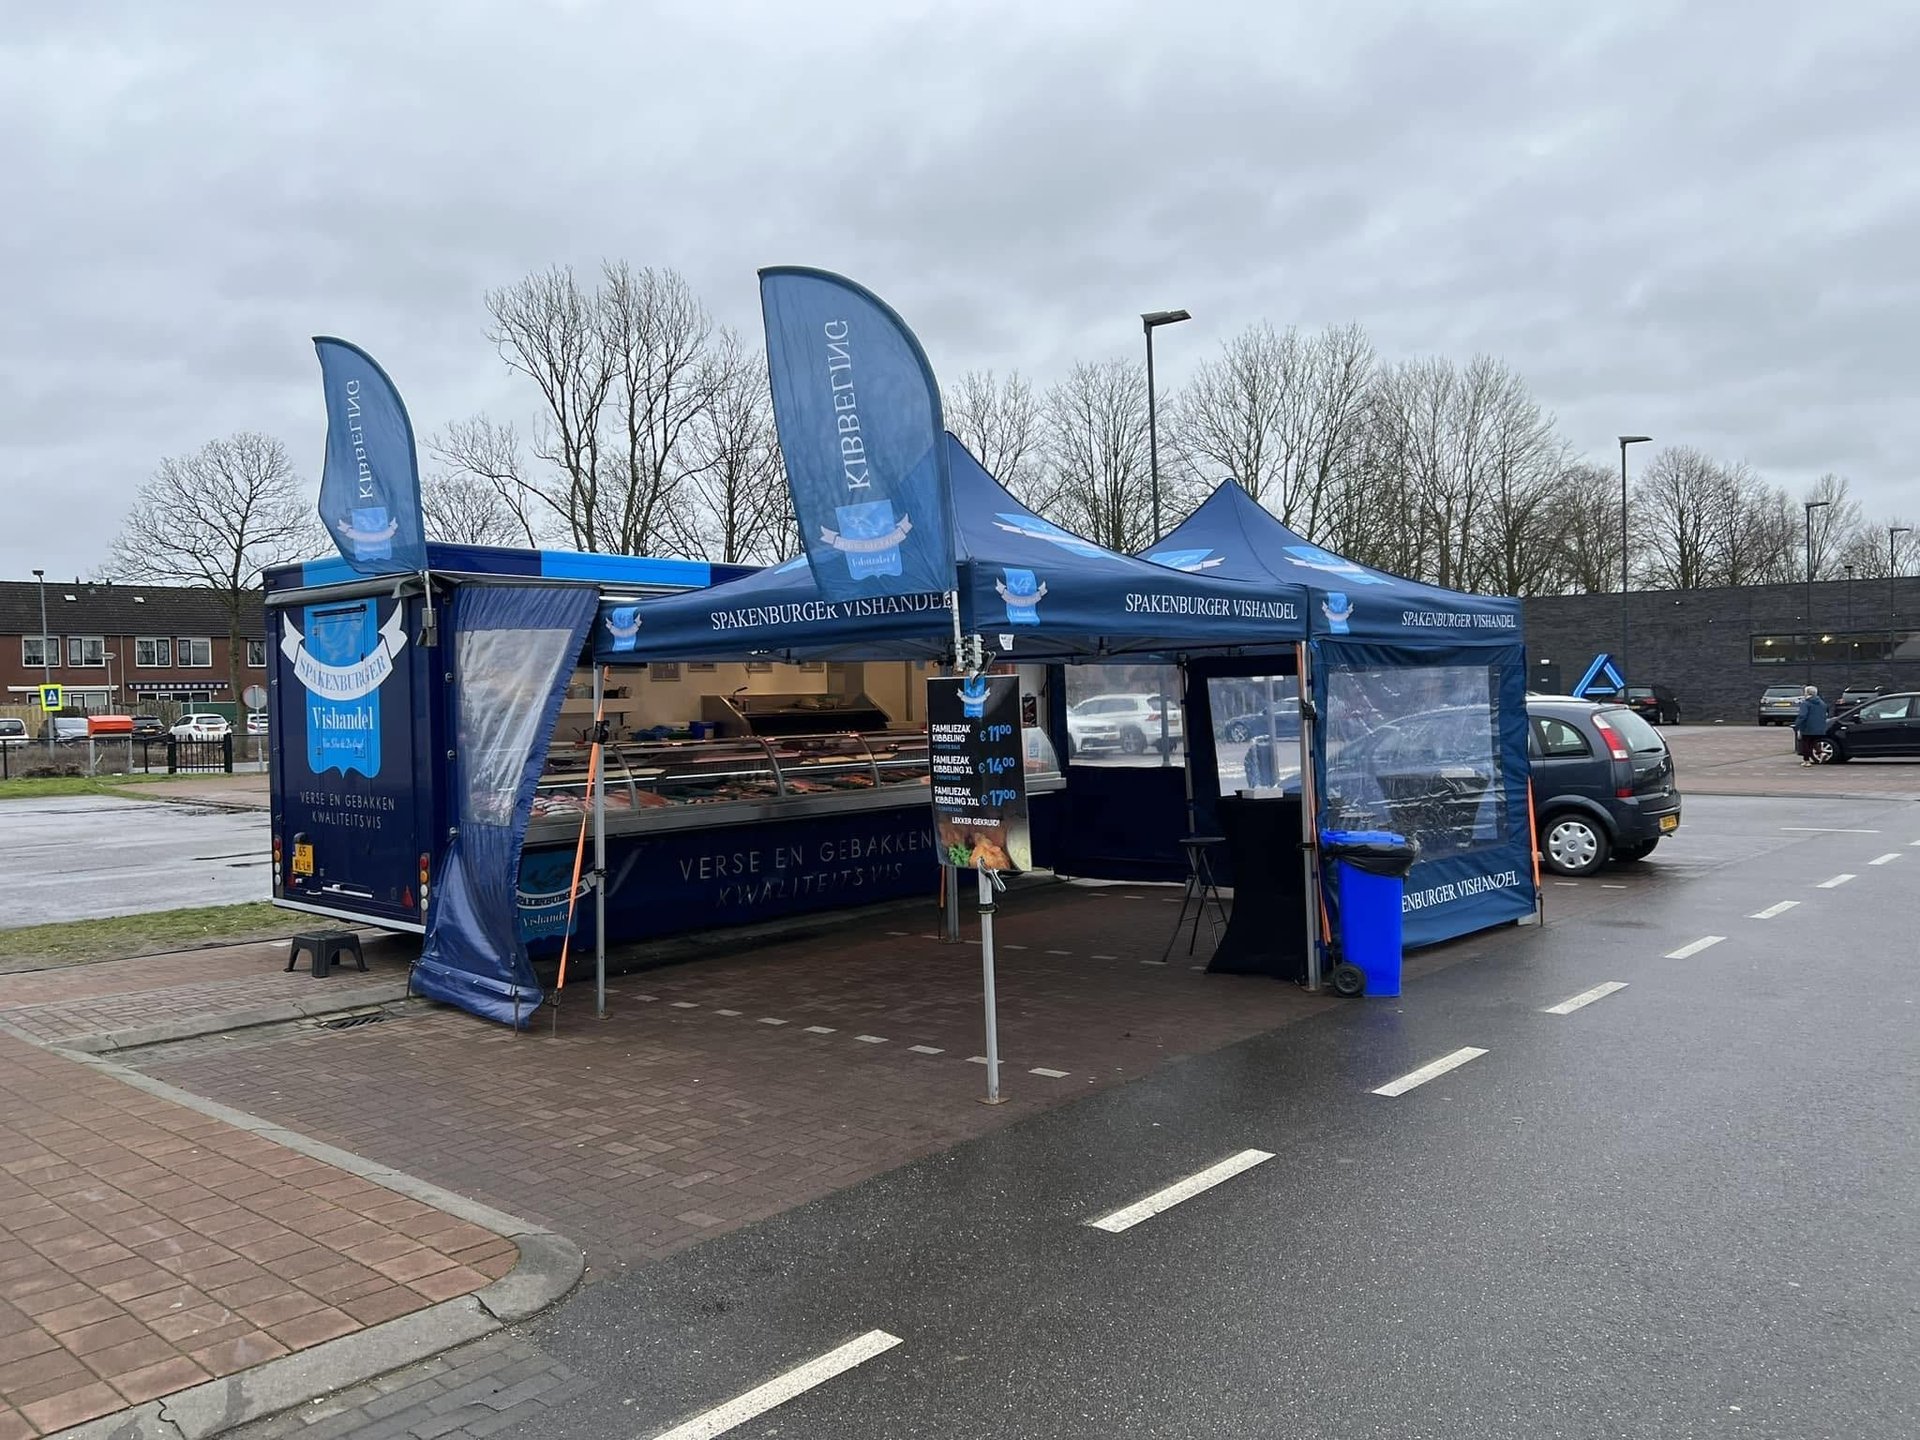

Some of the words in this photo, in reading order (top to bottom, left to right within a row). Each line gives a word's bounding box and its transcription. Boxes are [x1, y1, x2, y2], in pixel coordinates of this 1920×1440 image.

[1125, 593, 1230, 616] SPAKENBURGER
[1232, 598, 1298, 620] VISHANDEL
[710, 601, 838, 631] SPAKENBURGER
[1402, 611, 1471, 628] SPAKENBURGER
[1473, 614, 1516, 628] VISHANDEL
[299, 655, 386, 692] SPAKENBURGER
[312, 707, 373, 730] Vishandel
[932, 724, 971, 733] FAMILIEZAK
[932, 734, 966, 743] KIBBELING
[933, 755, 970, 765] FAMILIEZAK
[933, 765, 965, 774] KIBBELING
[965, 766, 974, 775] XL
[934, 786, 971, 797] FAMILIEZAK
[300, 791, 325, 806] VERSE
[329, 793, 341, 806] EN
[345, 795, 395, 811] GEBAKKEN
[935, 796, 966, 806] KIBBELING
[967, 797, 980, 807] XXL
[311, 812, 382, 830] KWALITEITSVIS
[951, 816, 972, 825] LEKKER
[679, 851, 761, 881] VERSE
[775, 845, 803, 869] EN
[819, 829, 933, 862] GEBAKKEN
[1402, 884, 1457, 912] ENBURGER
[1457, 871, 1519, 896] VISHANDEL
